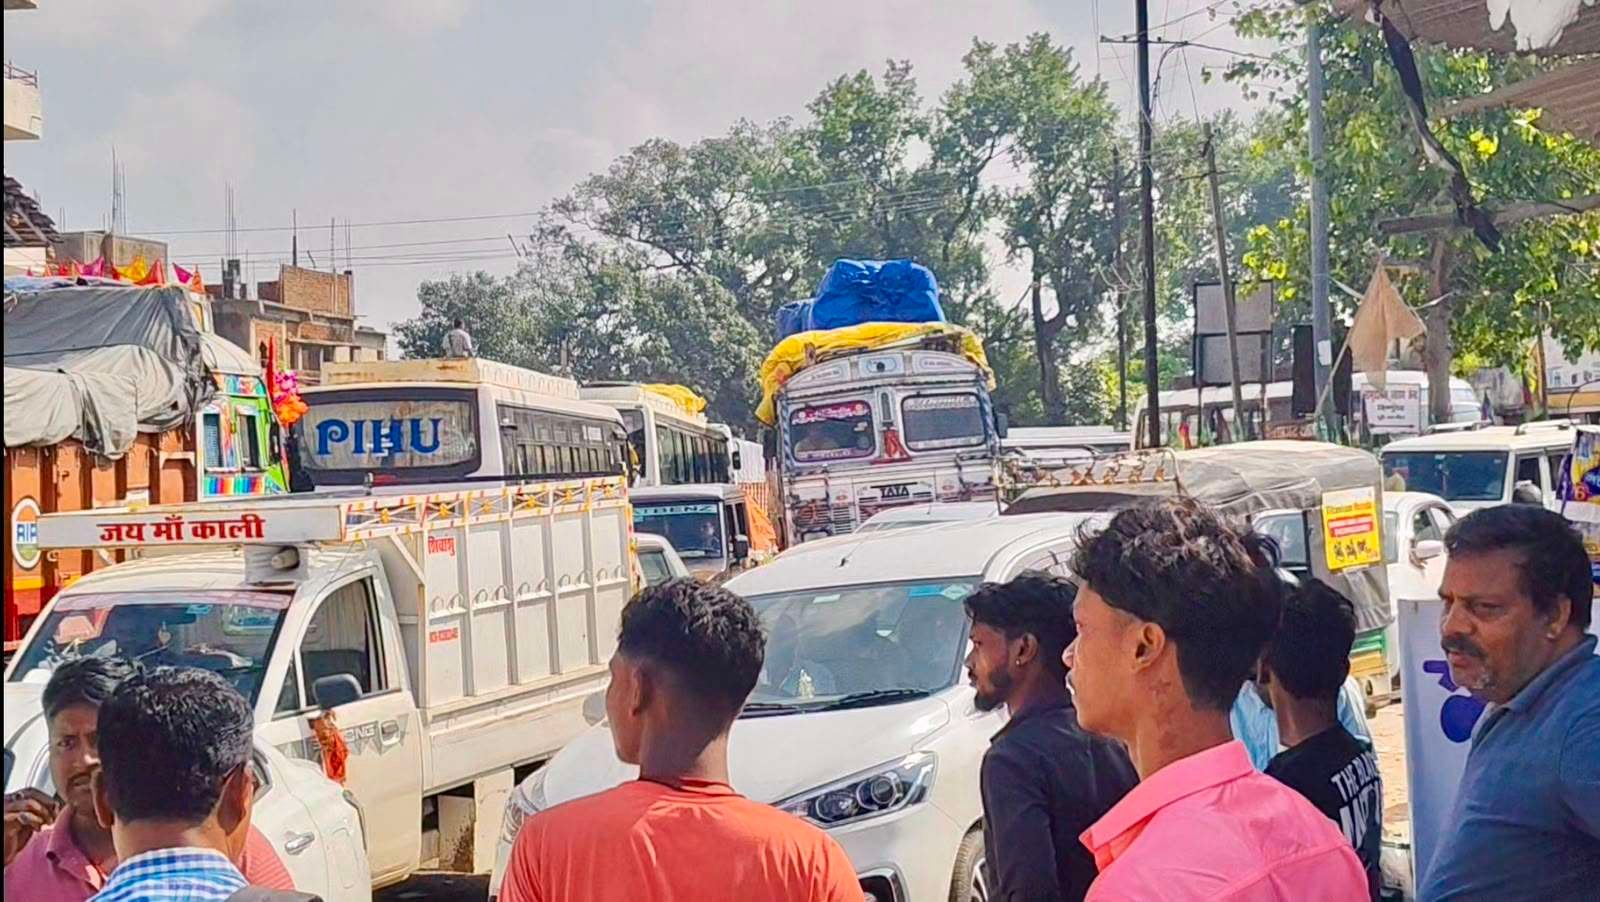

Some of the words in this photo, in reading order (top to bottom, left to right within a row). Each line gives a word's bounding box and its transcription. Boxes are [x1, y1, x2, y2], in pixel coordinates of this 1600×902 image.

[316, 418, 442, 455] PIHU
[881, 485, 910, 498] TATA
[97, 523, 146, 541] जय
[150, 514, 185, 541] माँ
[188, 513, 266, 539] काली
[1331, 764, 1359, 803] THE
